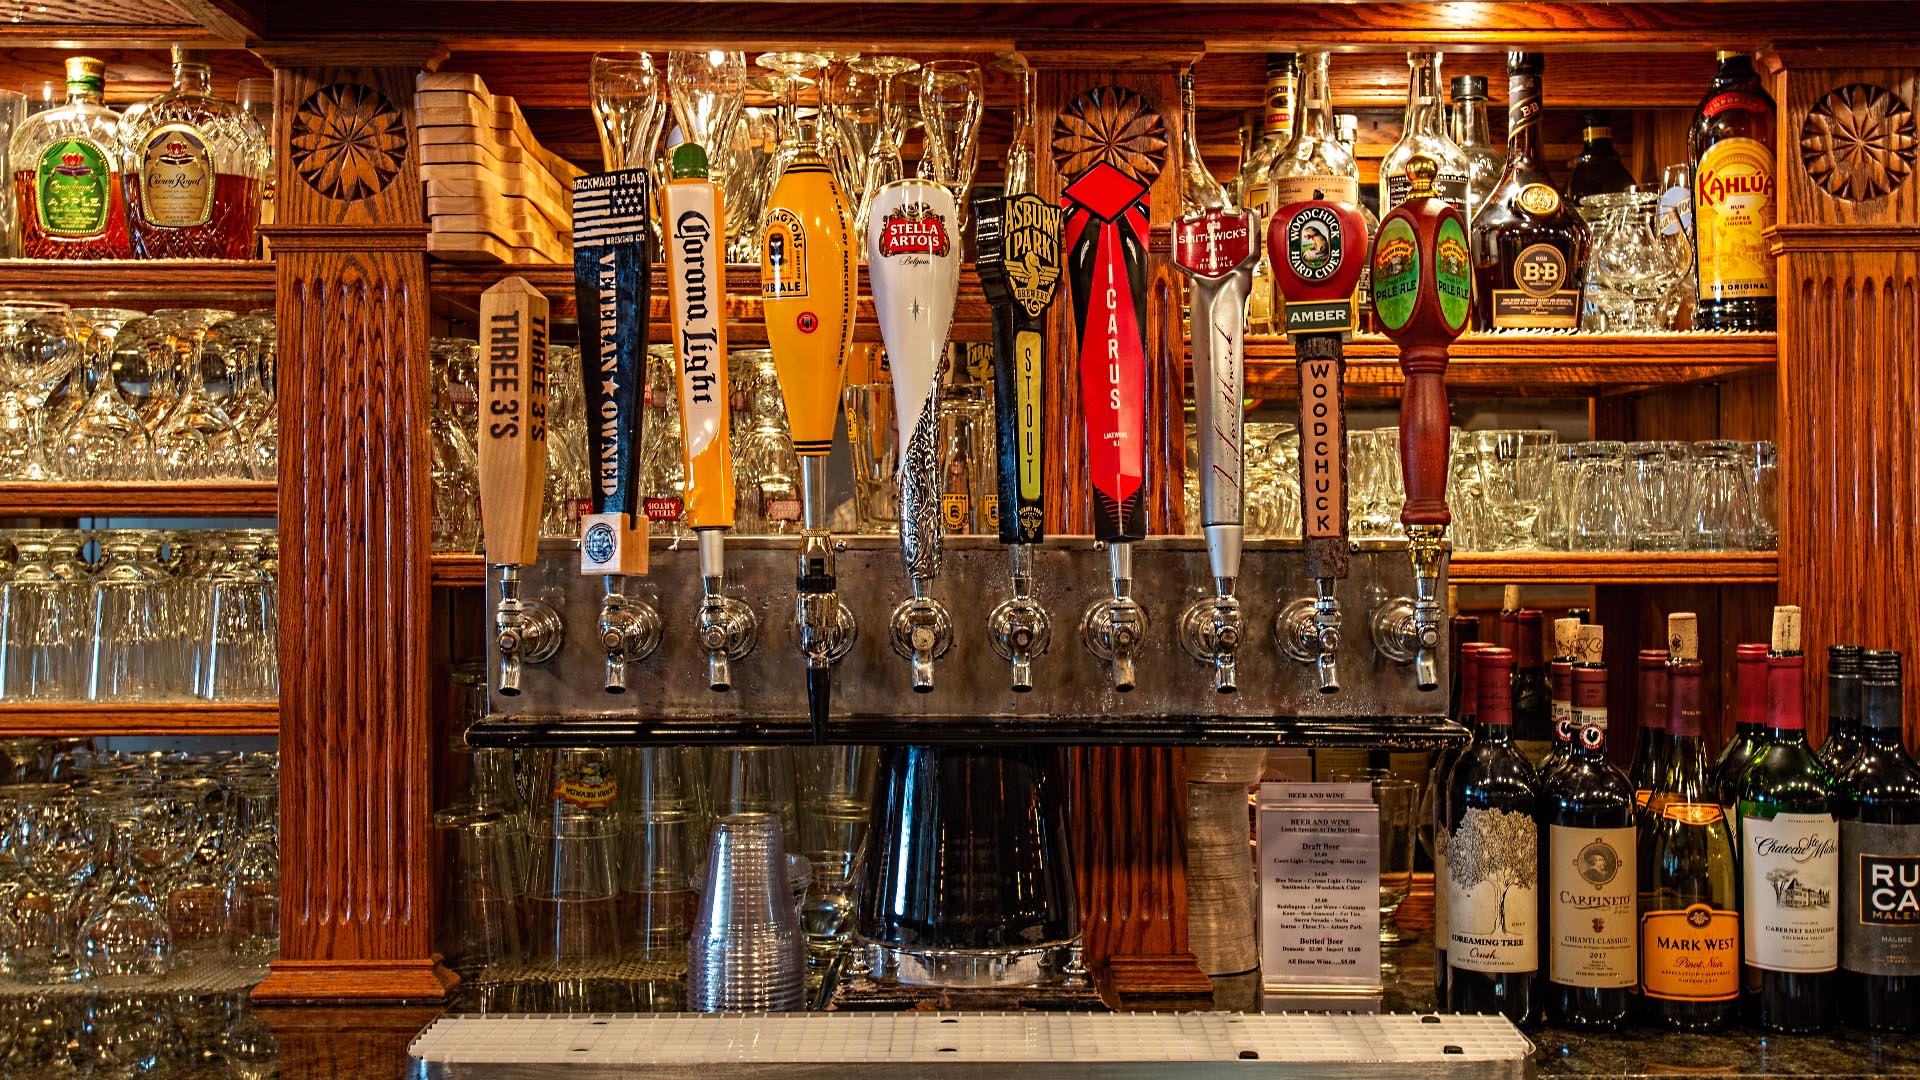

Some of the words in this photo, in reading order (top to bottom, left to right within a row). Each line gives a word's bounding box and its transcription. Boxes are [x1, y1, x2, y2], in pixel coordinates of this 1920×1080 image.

[148, 174, 175, 188] Crown
[172, 174, 204, 188] Royal
[573, 175, 616, 190] BACKWARD
[620, 172, 645, 185] FLAG
[1699, 169, 1774, 207] KAHLÚA
[890, 222, 939, 236] STELLA
[1005, 200, 1060, 243] ASBURY
[1291, 208, 1340, 241] WOODCHUCK
[606, 234, 633, 244] BREWING
[890, 235, 940, 248] ARTOIS
[1014, 228, 1053, 264] PARK
[1178, 228, 1247, 244] SMITHWICK'S
[674, 210, 711, 321] Corona
[1292, 251, 1312, 278] HARD
[1315, 249, 1340, 279] CIDER
[780, 281, 801, 292] ALE
[1376, 288, 1398, 302] PALE
[1400, 280, 1417, 293] ALE
[1439, 280, 1455, 296] PALE
[1456, 287, 1469, 300] ALE
[1728, 282, 1769, 291] ORIGINAL
[600, 252, 618, 373] VETERAN
[1291, 309, 1346, 323] AMBER
[1106, 263, 1120, 410] ICARUS
[491, 310, 519, 392] THREE
[532, 316, 546, 397] THREE
[682, 328, 718, 404] Light
[490, 399, 519, 439] 3'S
[532, 402, 546, 442] 3'S
[1025, 347, 1033, 484] STOUT
[601, 400, 618, 495] OWNED
[1310, 363, 1330, 533] WOODCHUCK
[648, 509, 676, 517] STELLA
[1755, 836, 1806, 857] Chateau
[1813, 838, 1837, 859] Mich
[1872, 864, 1919, 887] RU
[1560, 890, 1631, 906] CARPINETO
[1872, 888, 1920, 911] CA
[1454, 934, 1499, 947] DREAMING
[1500, 939, 1524, 947] TREE
[1564, 936, 1595, 945] CHIANTI
[1597, 936, 1628, 945] CLASSICO
[1765, 925, 1802, 934] CABERNET
[1299, 937, 1325, 945] Bottled
[1327, 937, 1343, 945] Beer
[1657, 936, 1701, 951] MARK
[1704, 937, 1734, 951] WEST
[1469, 947, 1497, 960] Crush
[1673, 956, 1702, 970] Pinot
[1702, 957, 1723, 969] Noir
